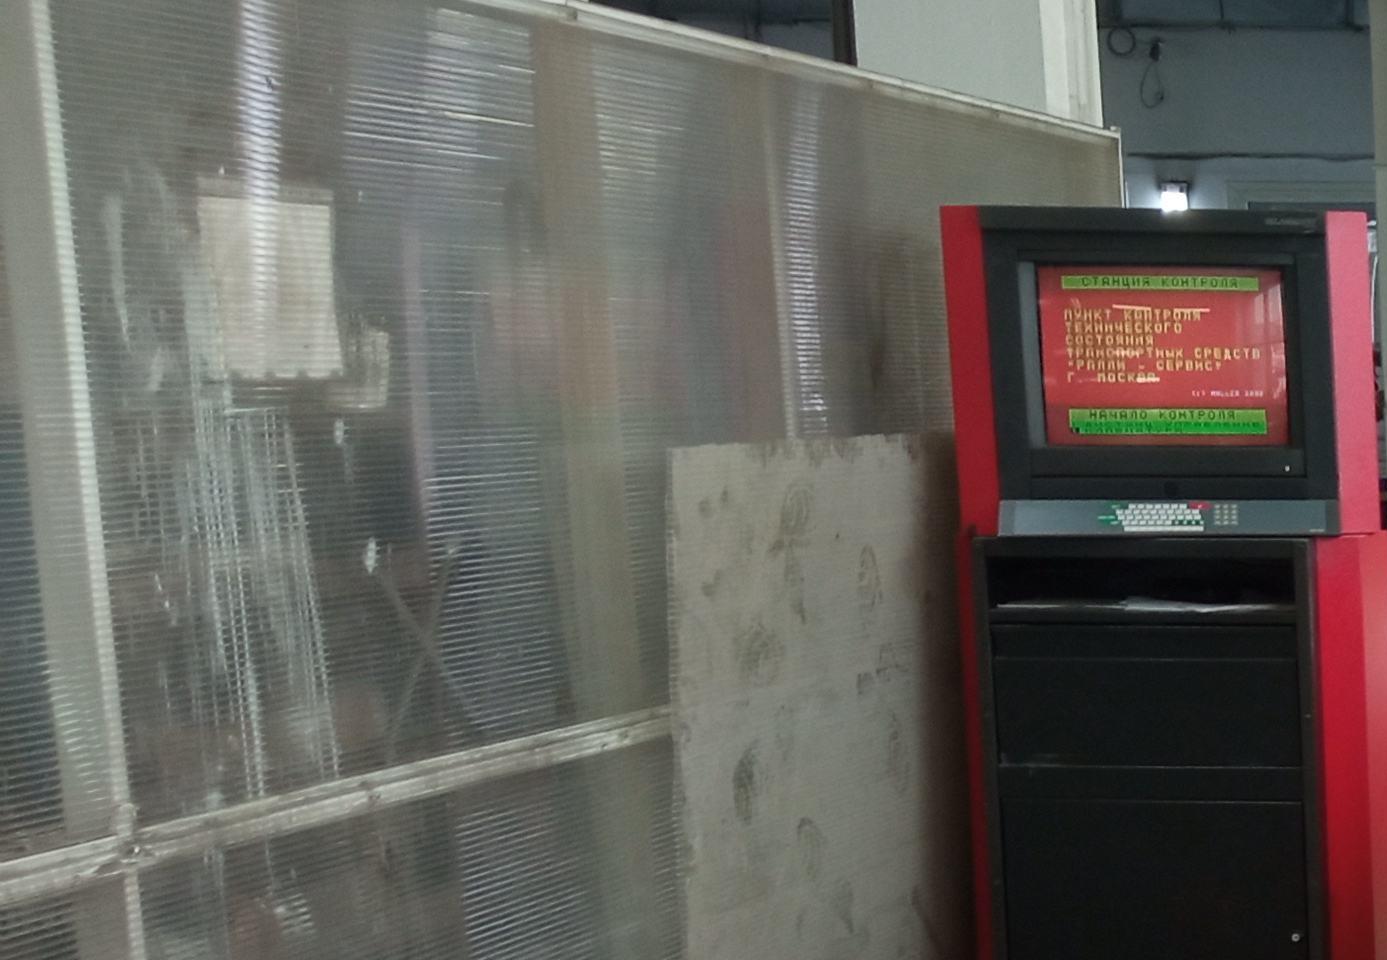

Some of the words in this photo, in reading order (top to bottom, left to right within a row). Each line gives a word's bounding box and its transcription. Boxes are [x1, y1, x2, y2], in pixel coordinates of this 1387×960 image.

[1082, 276, 1150, 289] СТАНЦИЯ
[1161, 277, 1239, 289] КОНТРОЛЯ
[1065, 321, 1184, 334] ТЕХНИЧЕСКОГО
[1065, 334, 1154, 346] СОСТОЯНИЯ
[1089, 410, 1147, 421] НАЧАЛО
[1159, 410, 1237, 421] КОНТРОЛЯ
